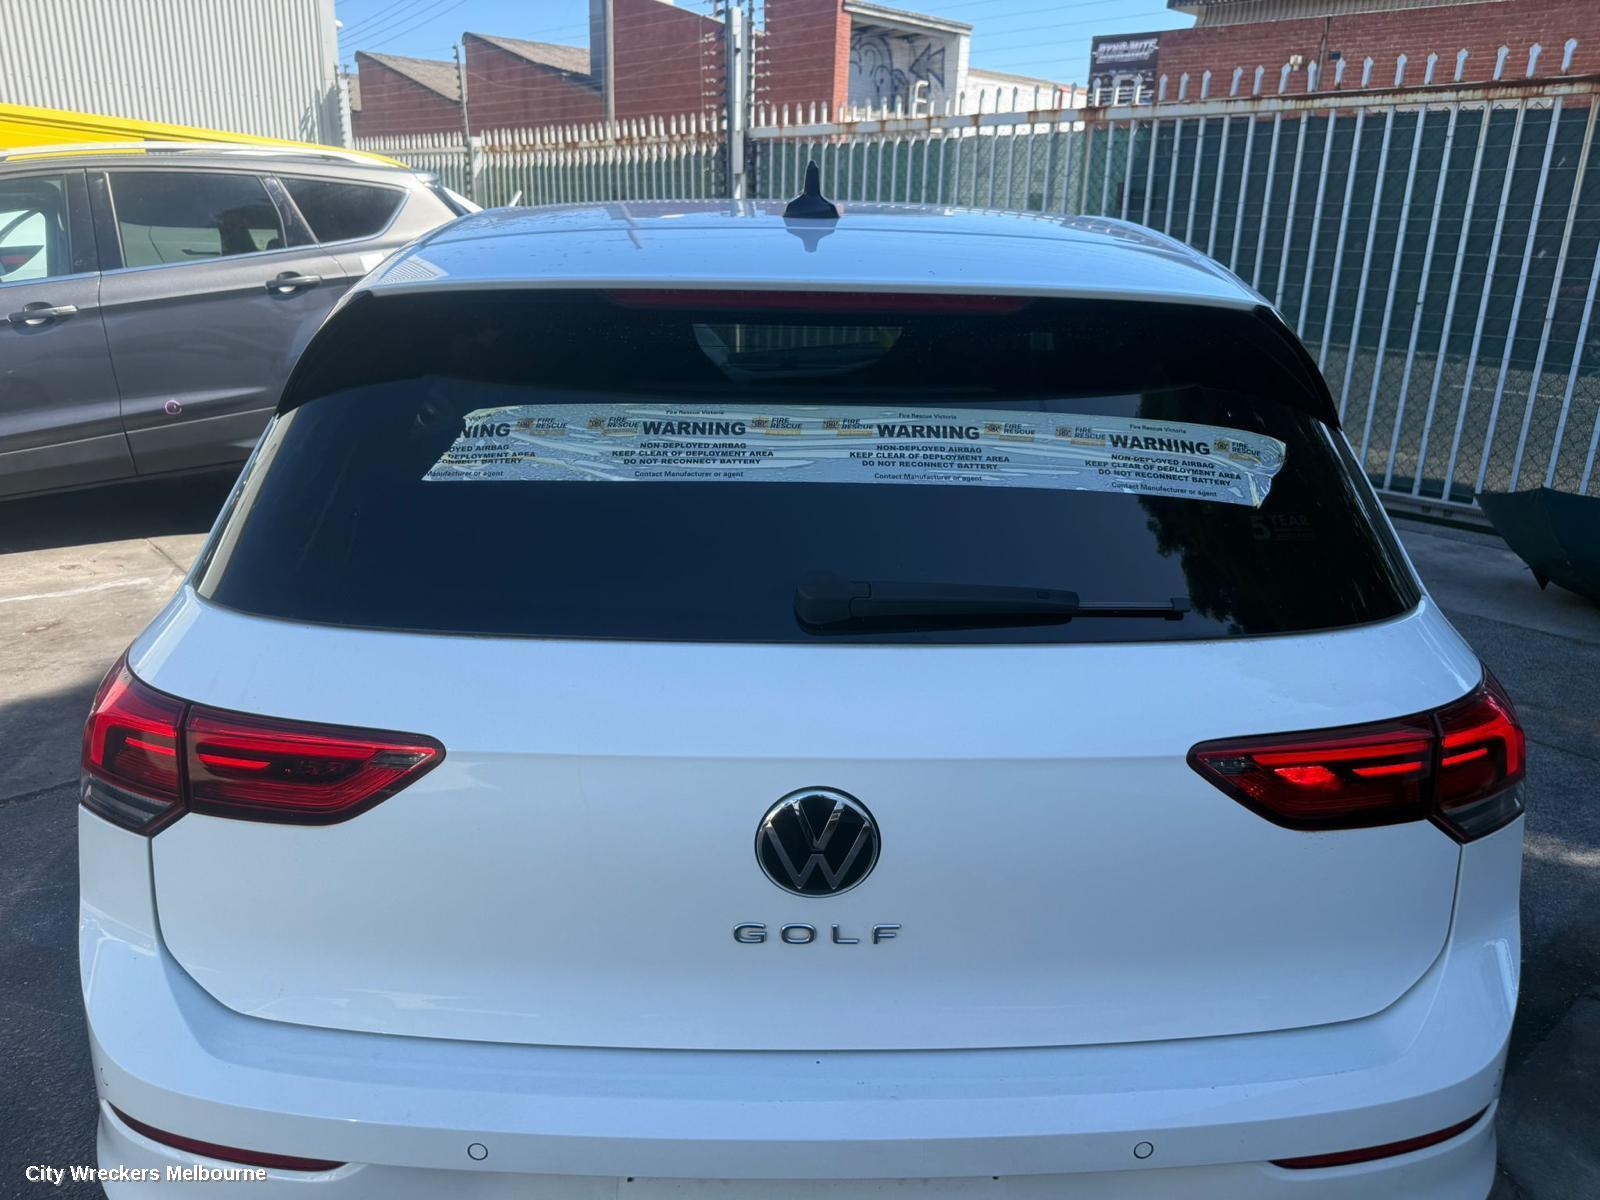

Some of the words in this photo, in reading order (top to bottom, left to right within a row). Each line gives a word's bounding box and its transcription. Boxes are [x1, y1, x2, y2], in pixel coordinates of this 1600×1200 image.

[643, 421, 746, 436] WARNING
[877, 424, 980, 440] WARNING
[1074, 432, 1106, 440] RESCUE
[1109, 434, 1210, 455] WARNING
[1231, 447, 1260, 456] RESCUE
[1232, 441, 1248, 449] FIRE
[922, 453, 983, 462] DEPLOYMENT
[1111, 454, 1178, 466] NON-DEPLOYED
[1182, 460, 1214, 469] AIRBAG
[1111, 461, 1141, 470] CLEAR
[1158, 465, 1216, 476] DEPLOYMENT
[1218, 472, 1242, 480] AREA
[1134, 471, 1189, 482] RECONNECT
[1192, 476, 1230, 486] BATTERY
[1111, 481, 1139, 490] Contact
[1140, 483, 1186, 494] Manufacturer
[733, 922, 902, 944] GOLF
